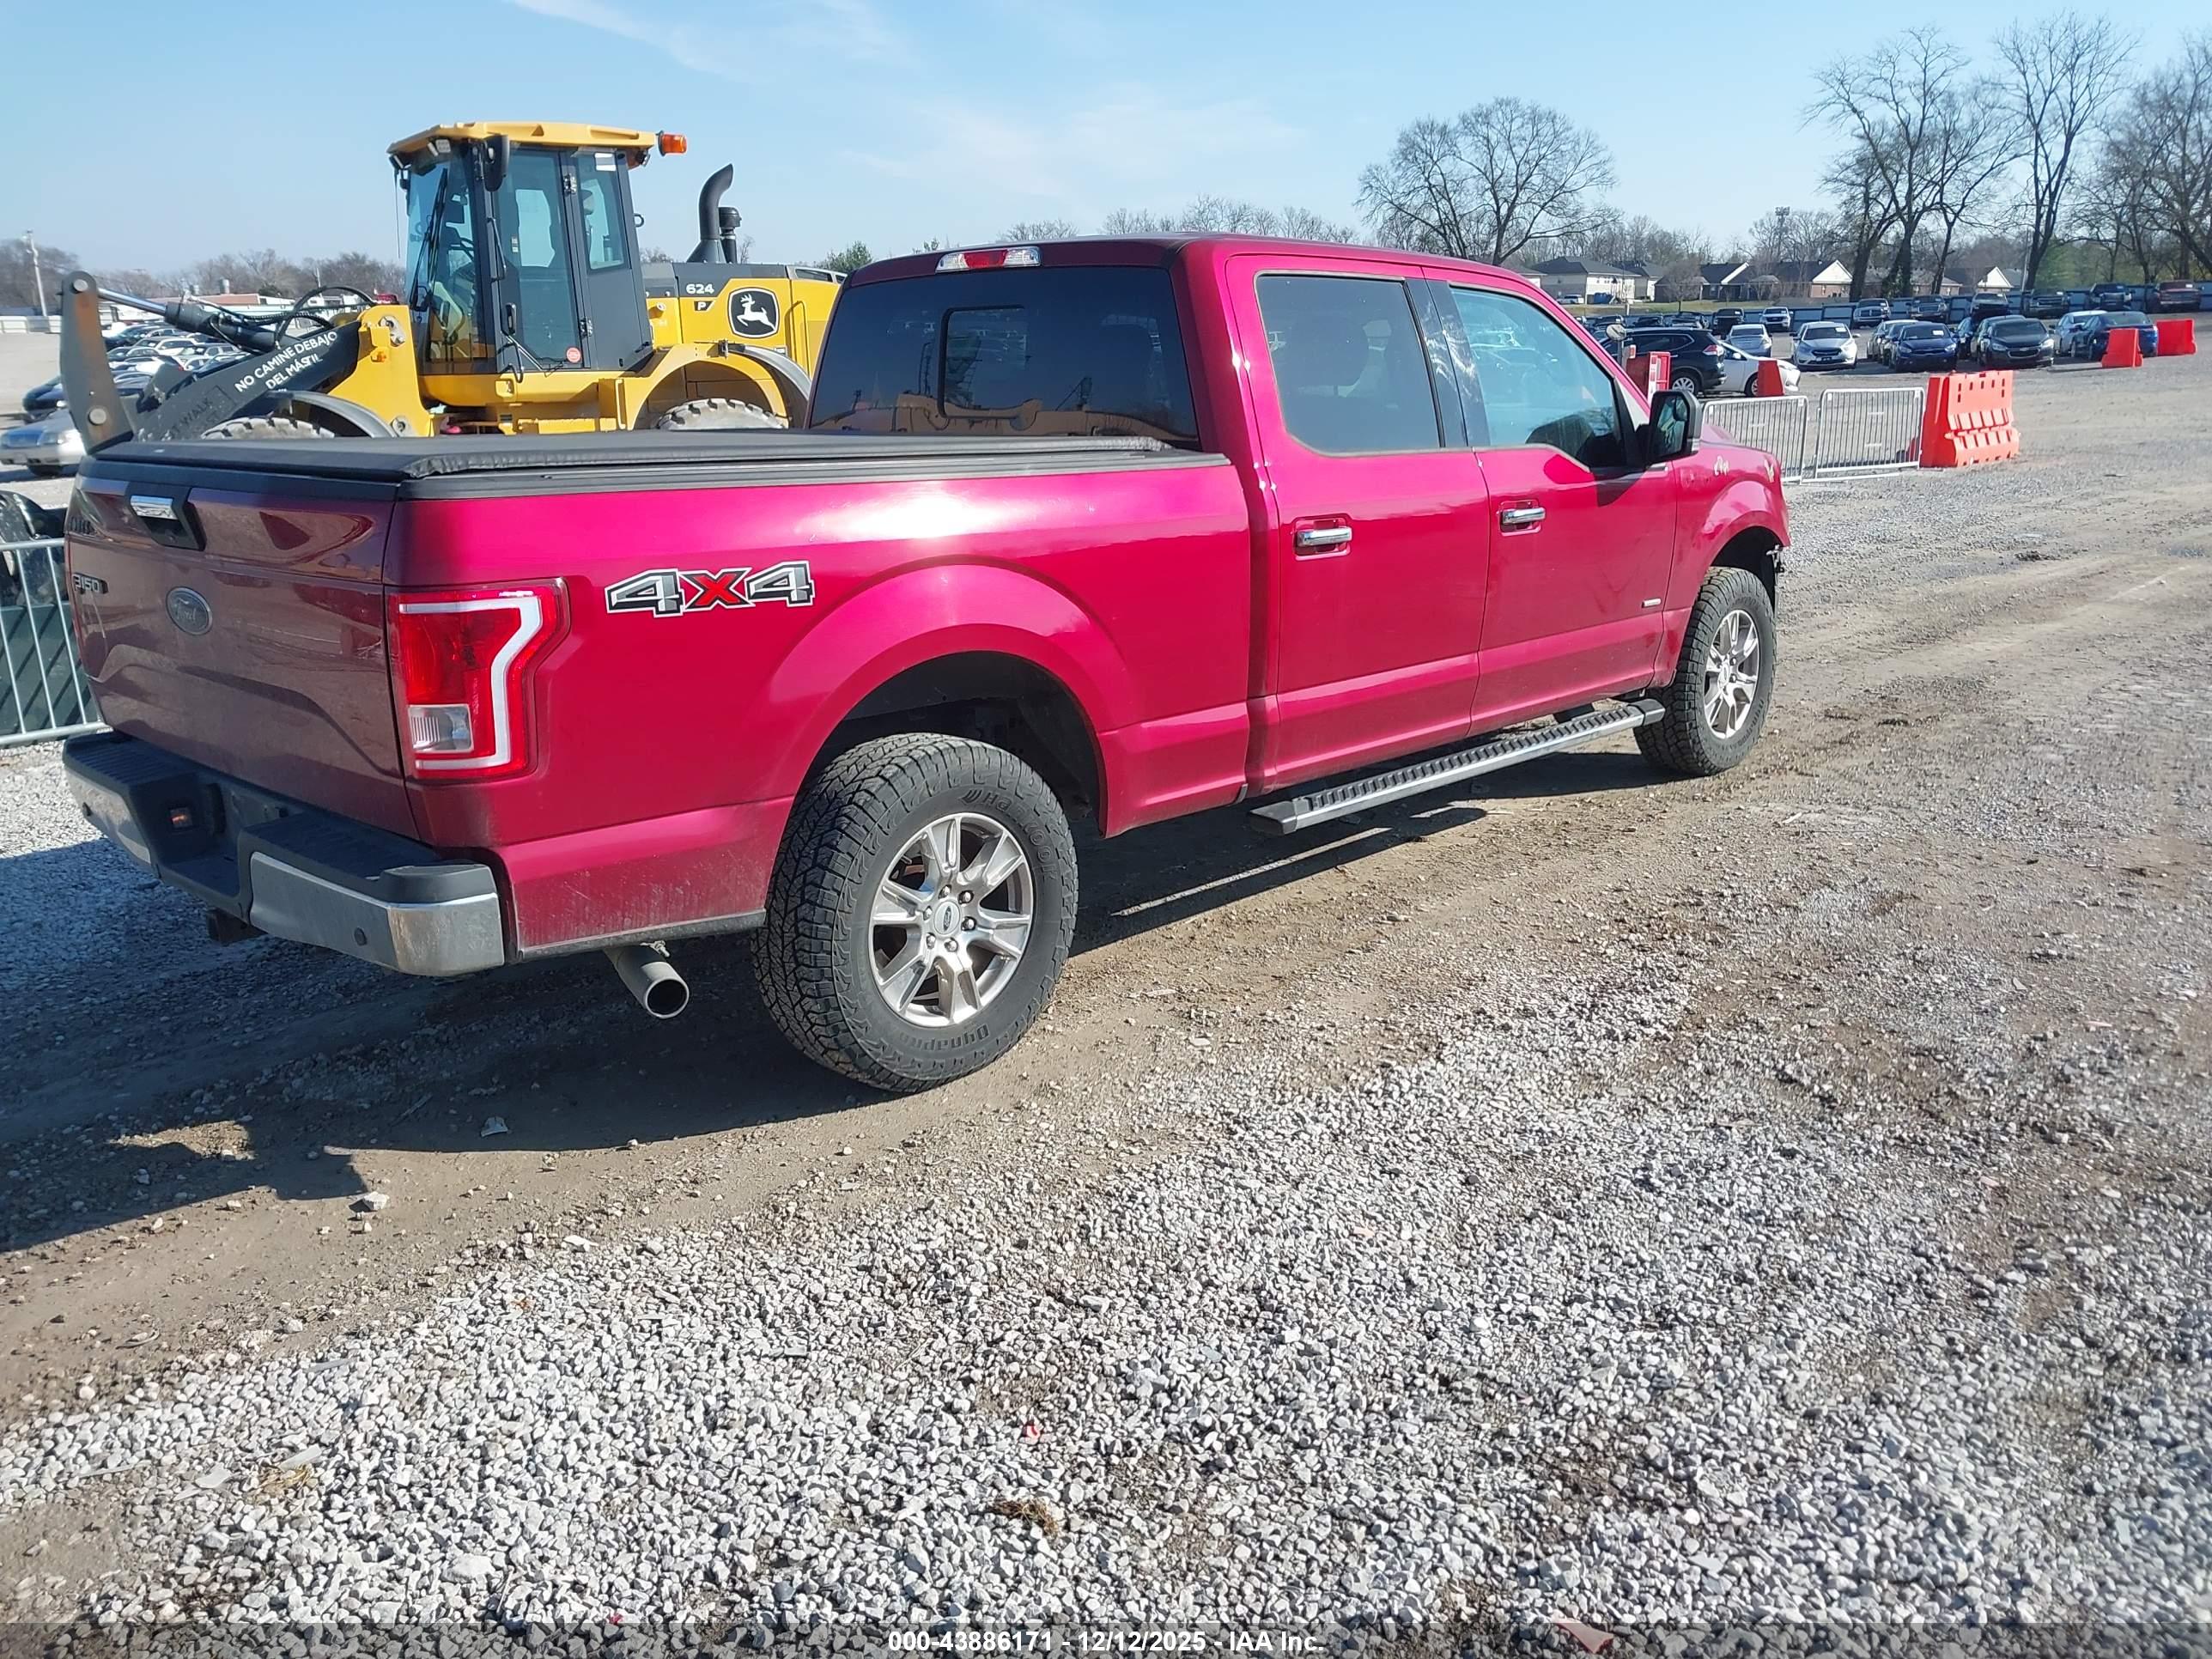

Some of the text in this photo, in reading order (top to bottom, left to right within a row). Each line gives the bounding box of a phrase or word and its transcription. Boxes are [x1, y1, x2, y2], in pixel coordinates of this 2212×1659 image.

[686, 283, 714, 295] 624
[697, 301, 707, 311] P
[234, 331, 337, 392] NO CAMINE DEBAJO
[265, 353, 323, 390] DEL MÁSTIL
